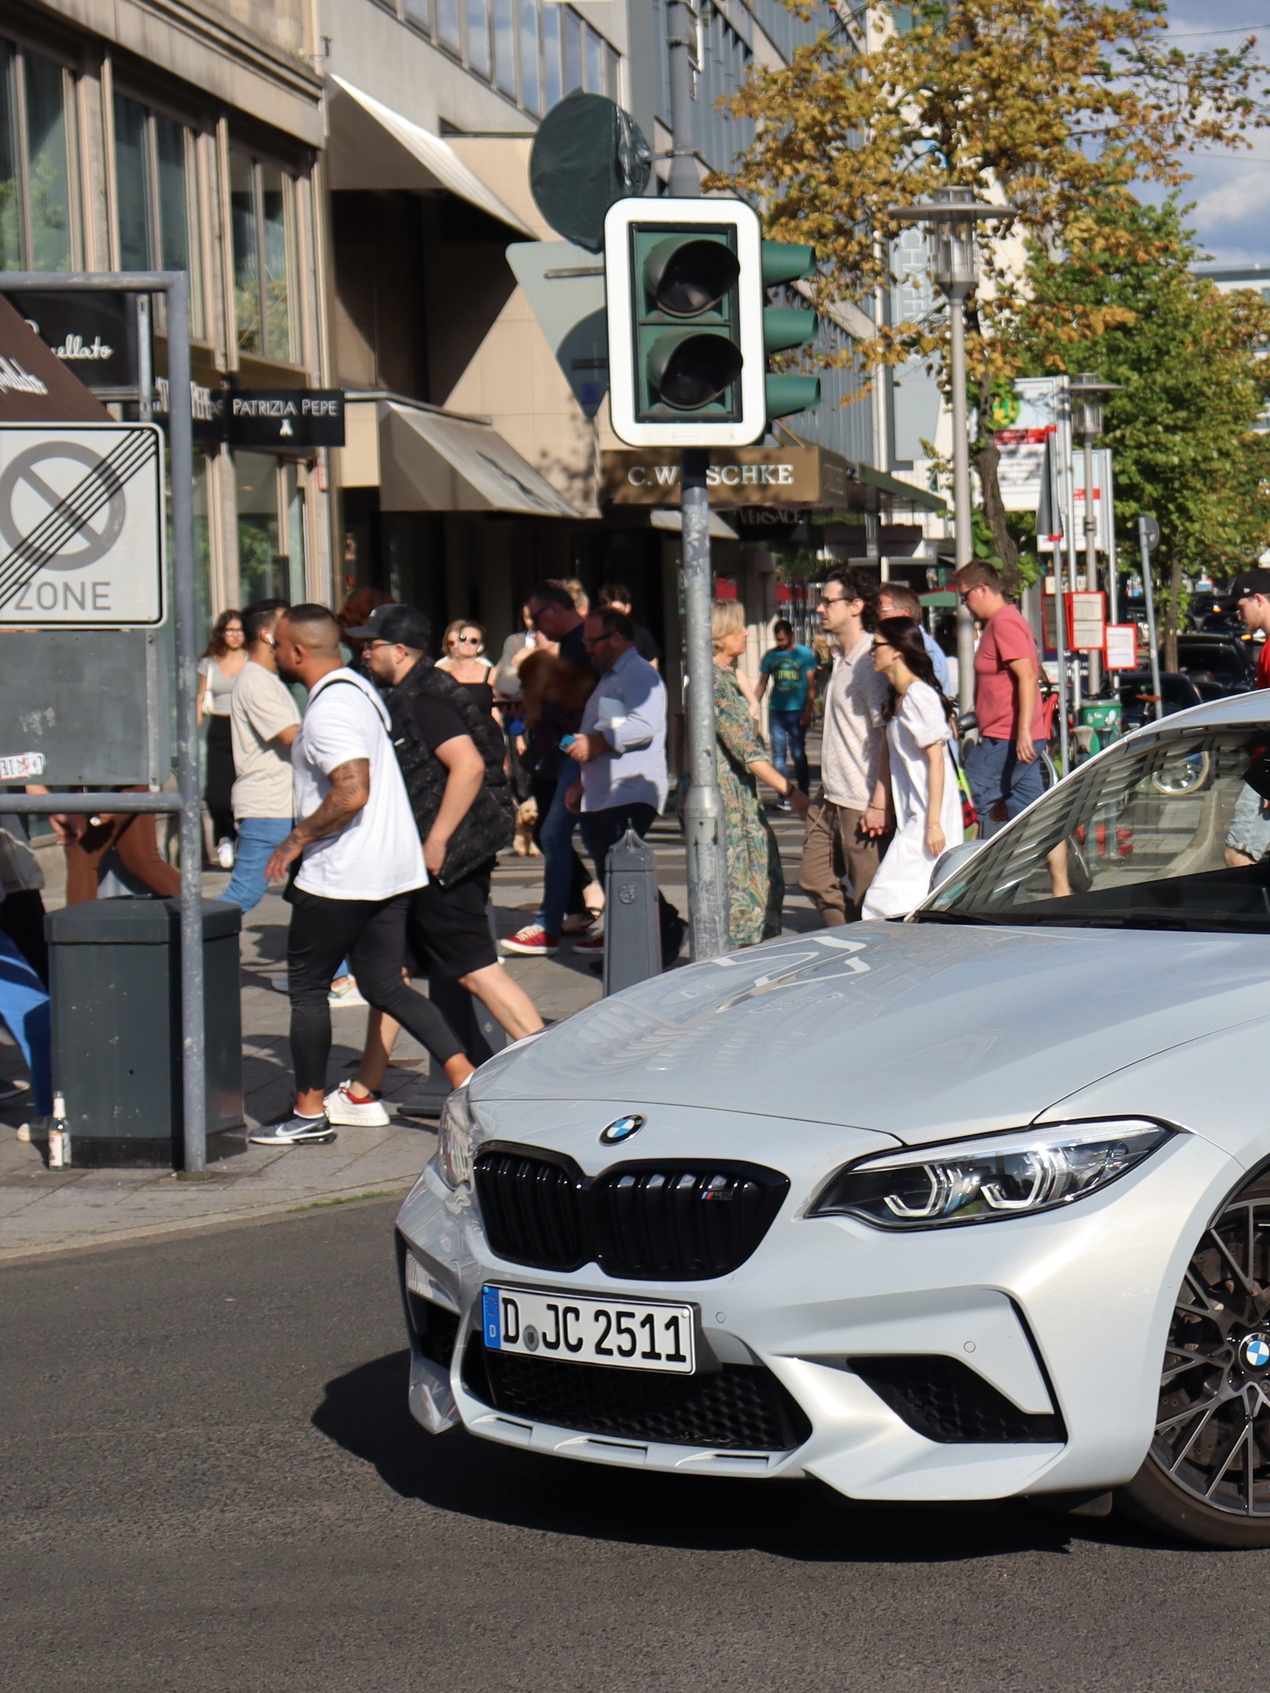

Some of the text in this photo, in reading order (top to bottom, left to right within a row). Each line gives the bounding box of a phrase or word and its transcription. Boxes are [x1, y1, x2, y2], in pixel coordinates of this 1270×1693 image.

[232, 399, 339, 416] PATRIZIA PEPE
[14, 581, 112, 611] ZONE
[488, 1324, 497, 1338] D
[502, 1297, 687, 1363] D JC 2511
